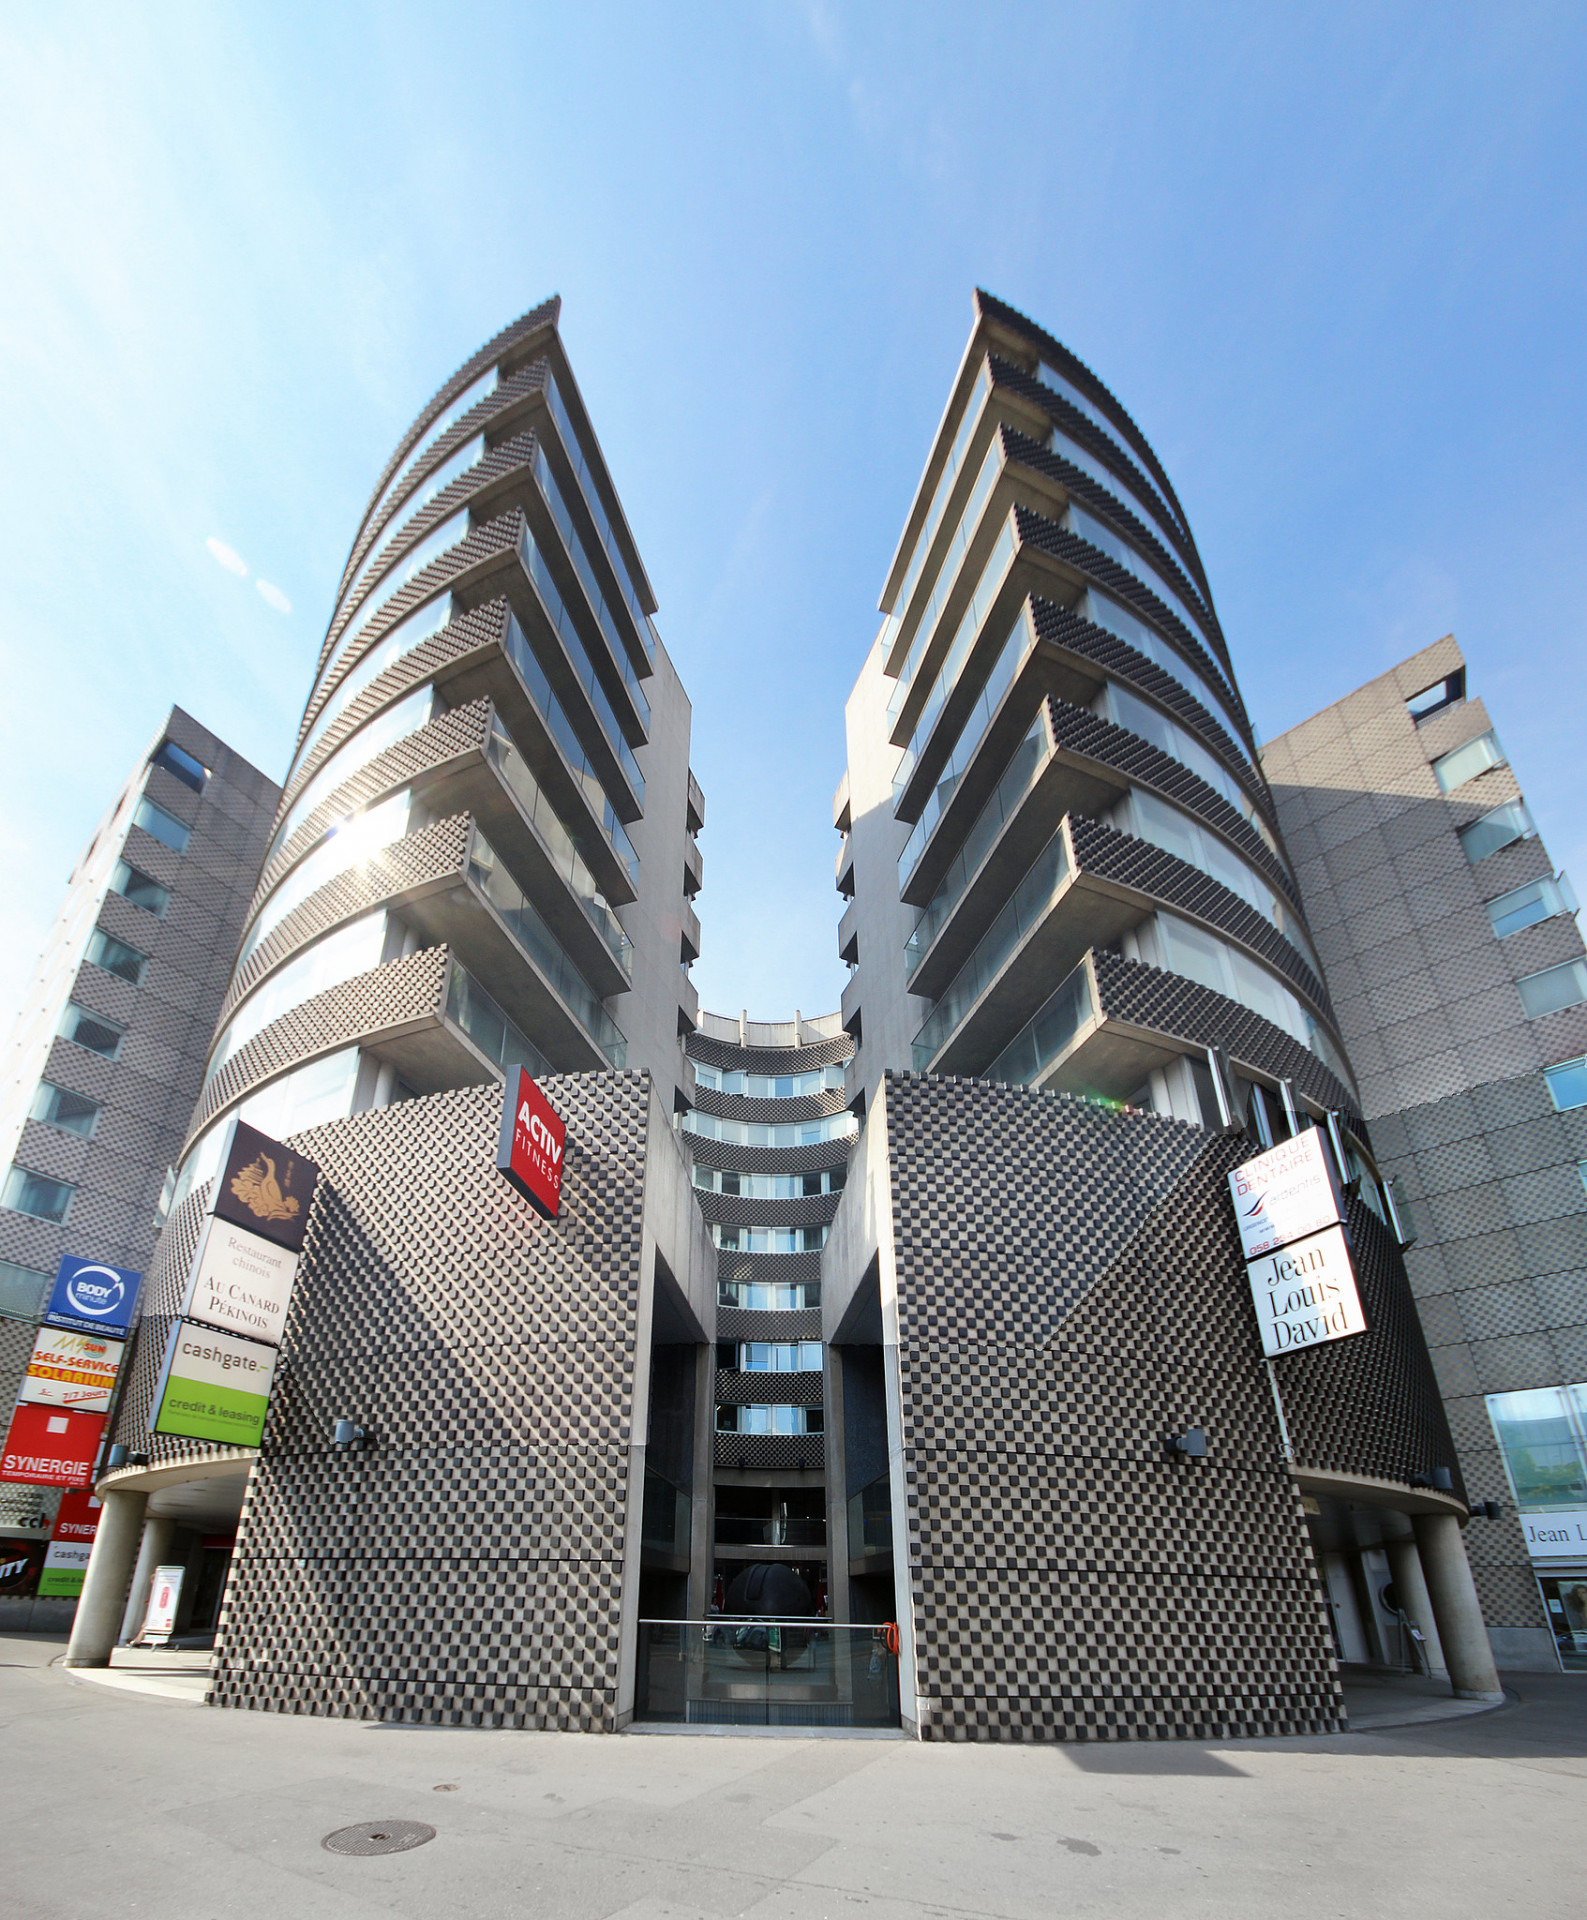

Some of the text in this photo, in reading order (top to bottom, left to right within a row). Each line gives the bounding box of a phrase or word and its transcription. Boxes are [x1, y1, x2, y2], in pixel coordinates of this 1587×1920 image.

[518, 1100, 562, 1165] ACTIV
[515, 1127, 559, 1189] FITNESS
[1234, 1134, 1311, 1183] CLINIQUE
[1236, 1148, 1313, 1197] DENTAIRE
[227, 1236, 282, 1269] Restaurant
[1249, 1241, 1270, 1256] 058
[232, 1256, 271, 1279] chinois
[1267, 1248, 1325, 1287] Jean
[76, 1281, 112, 1298] BODY
[203, 1275, 280, 1314] AU CANARD
[1266, 1275, 1341, 1319] Louis
[208, 1295, 268, 1329] PÉKINOIS
[1270, 1301, 1349, 1351] David
[33, 1350, 120, 1374] SELF-SERVICE
[83, 1342, 107, 1354] SUN
[26, 1364, 116, 1389] SOLARIUM
[168, 1398, 206, 1414] credit
[207, 1404, 217, 1416] &
[219, 1406, 260, 1426] leasing
[3, 1454, 90, 1476] SYNERGIE
[1528, 1525, 1570, 1543] Jean
